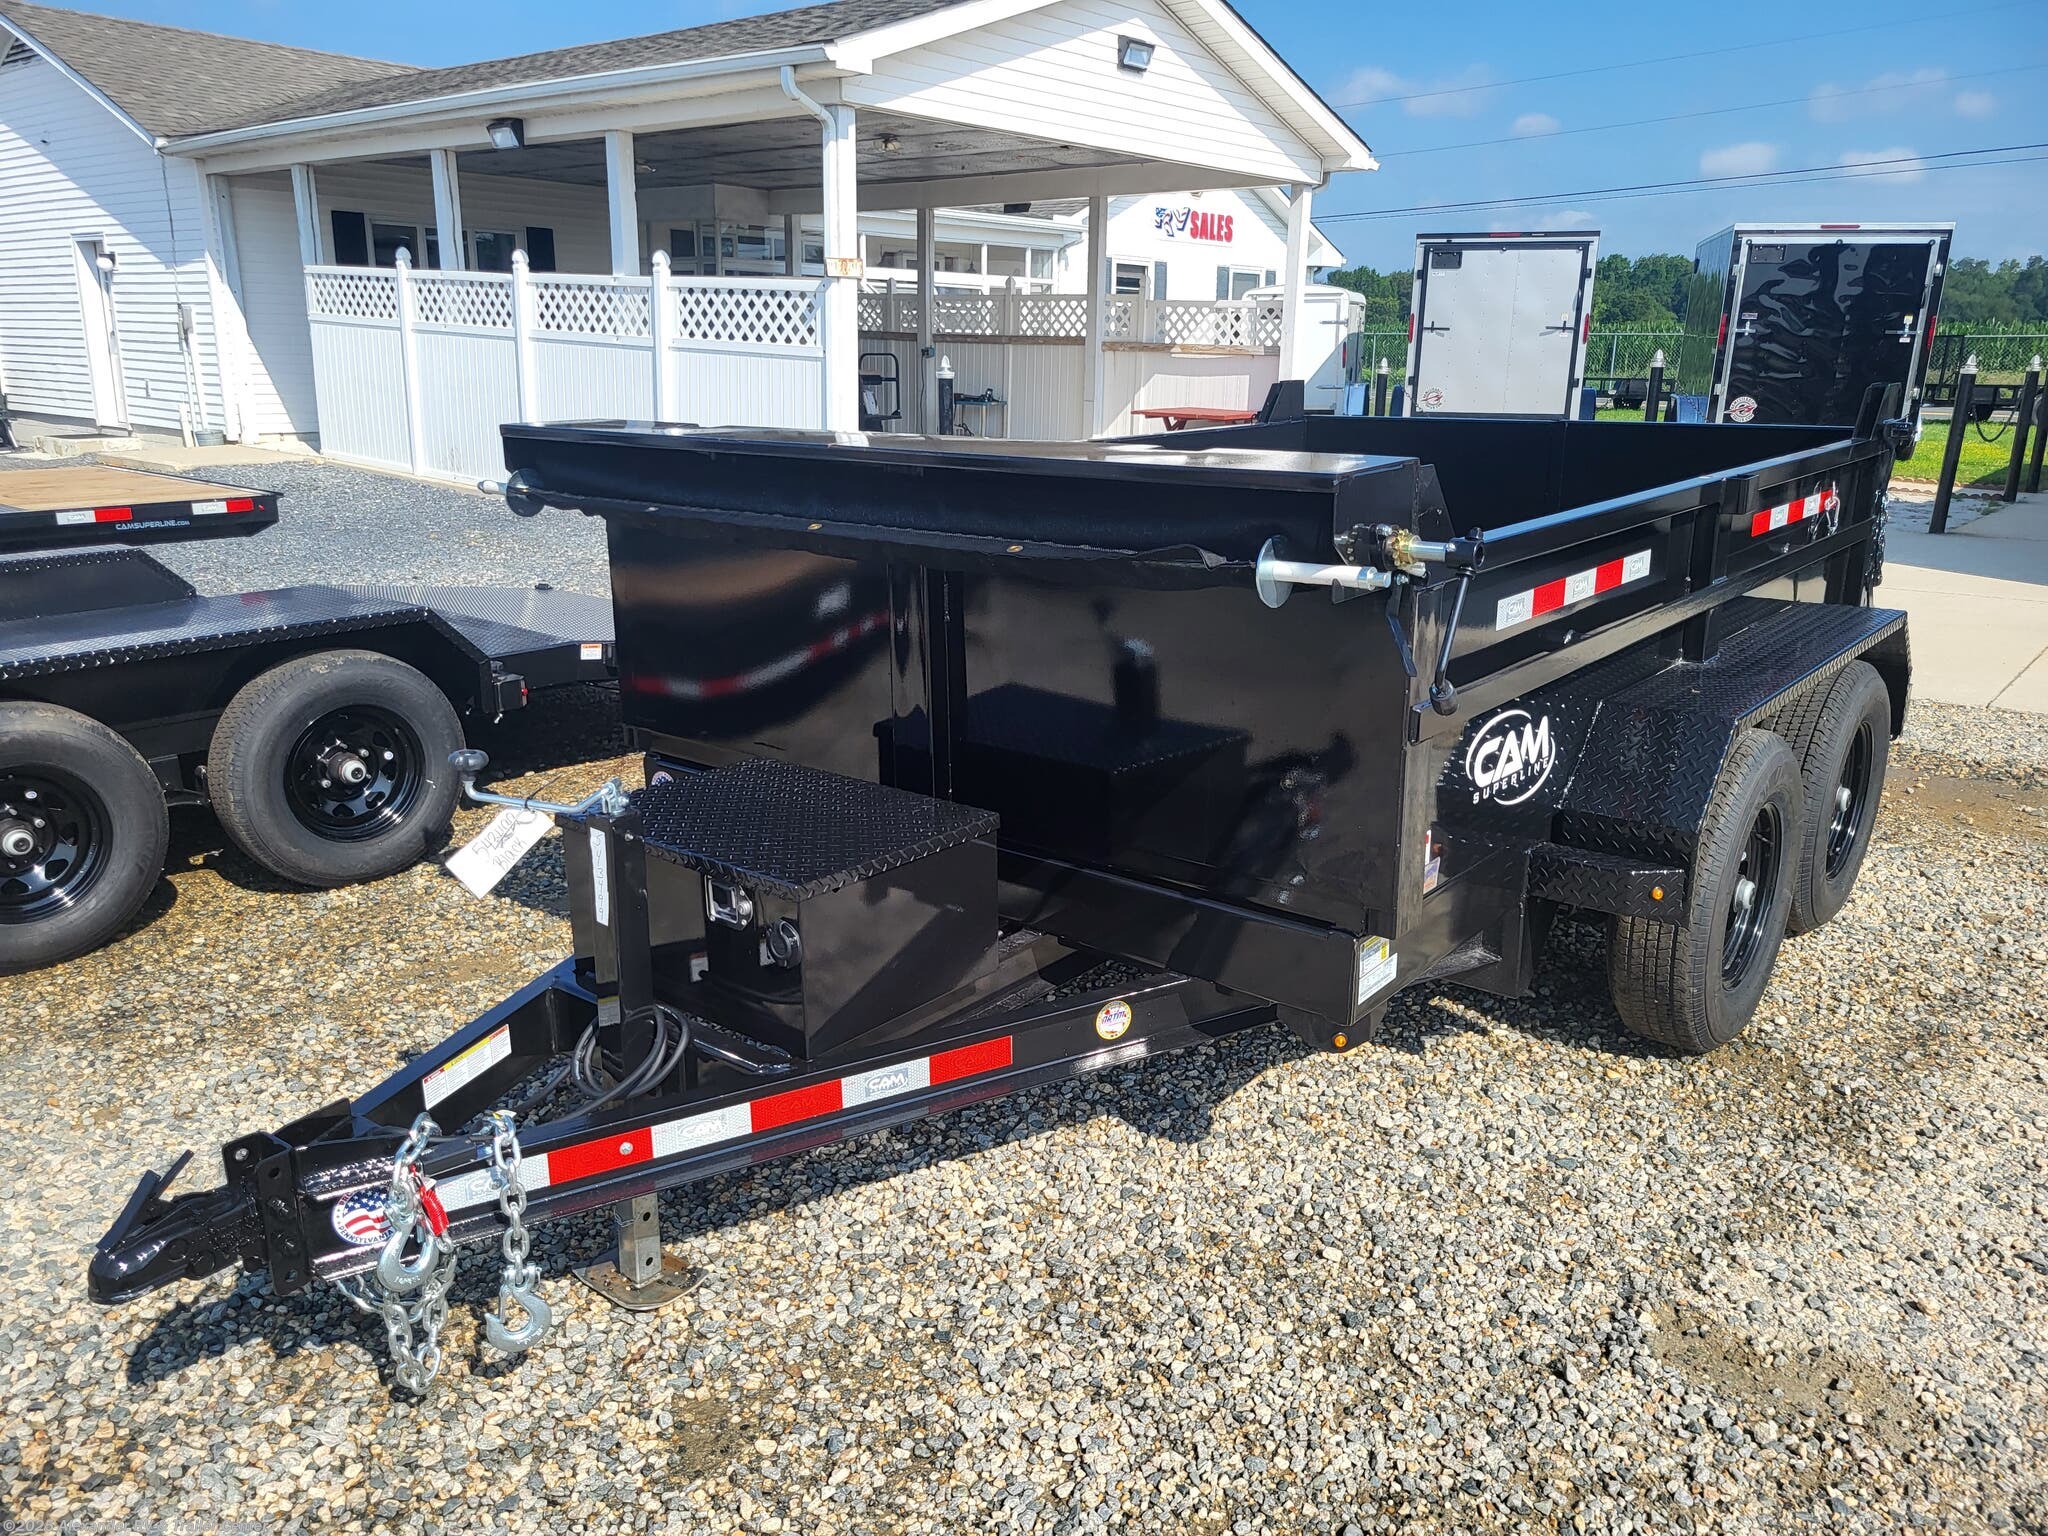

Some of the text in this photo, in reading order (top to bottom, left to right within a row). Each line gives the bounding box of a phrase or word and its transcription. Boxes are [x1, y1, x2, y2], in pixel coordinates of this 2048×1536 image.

[1190, 210, 1234, 243] SALES
[1474, 715, 1549, 788] CAM
[1472, 757, 1549, 805] SUPERLINE
[492, 837, 528, 872] Black
[868, 1072, 905, 1089] CAM
[338, 1225, 393, 1244] PENNSYLVANIA
